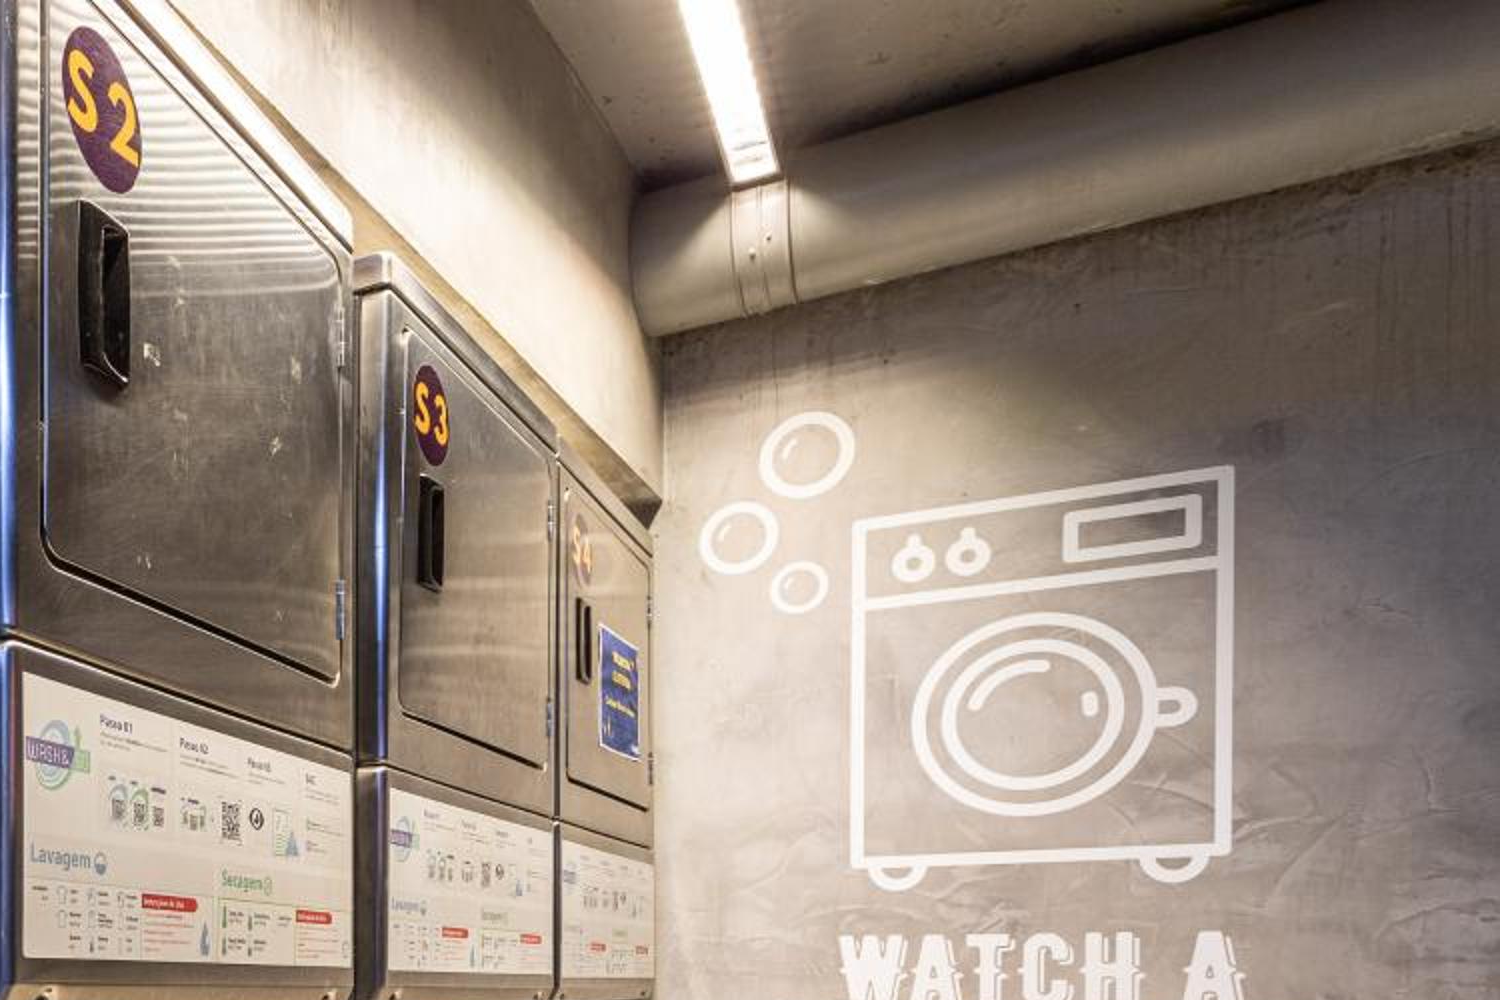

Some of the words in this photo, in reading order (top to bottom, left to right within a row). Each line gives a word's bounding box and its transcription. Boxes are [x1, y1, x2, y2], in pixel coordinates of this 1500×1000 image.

[67, 49, 139, 168] S2
[414, 381, 449, 446] S3
[30, 841, 91, 871] Lavagem
